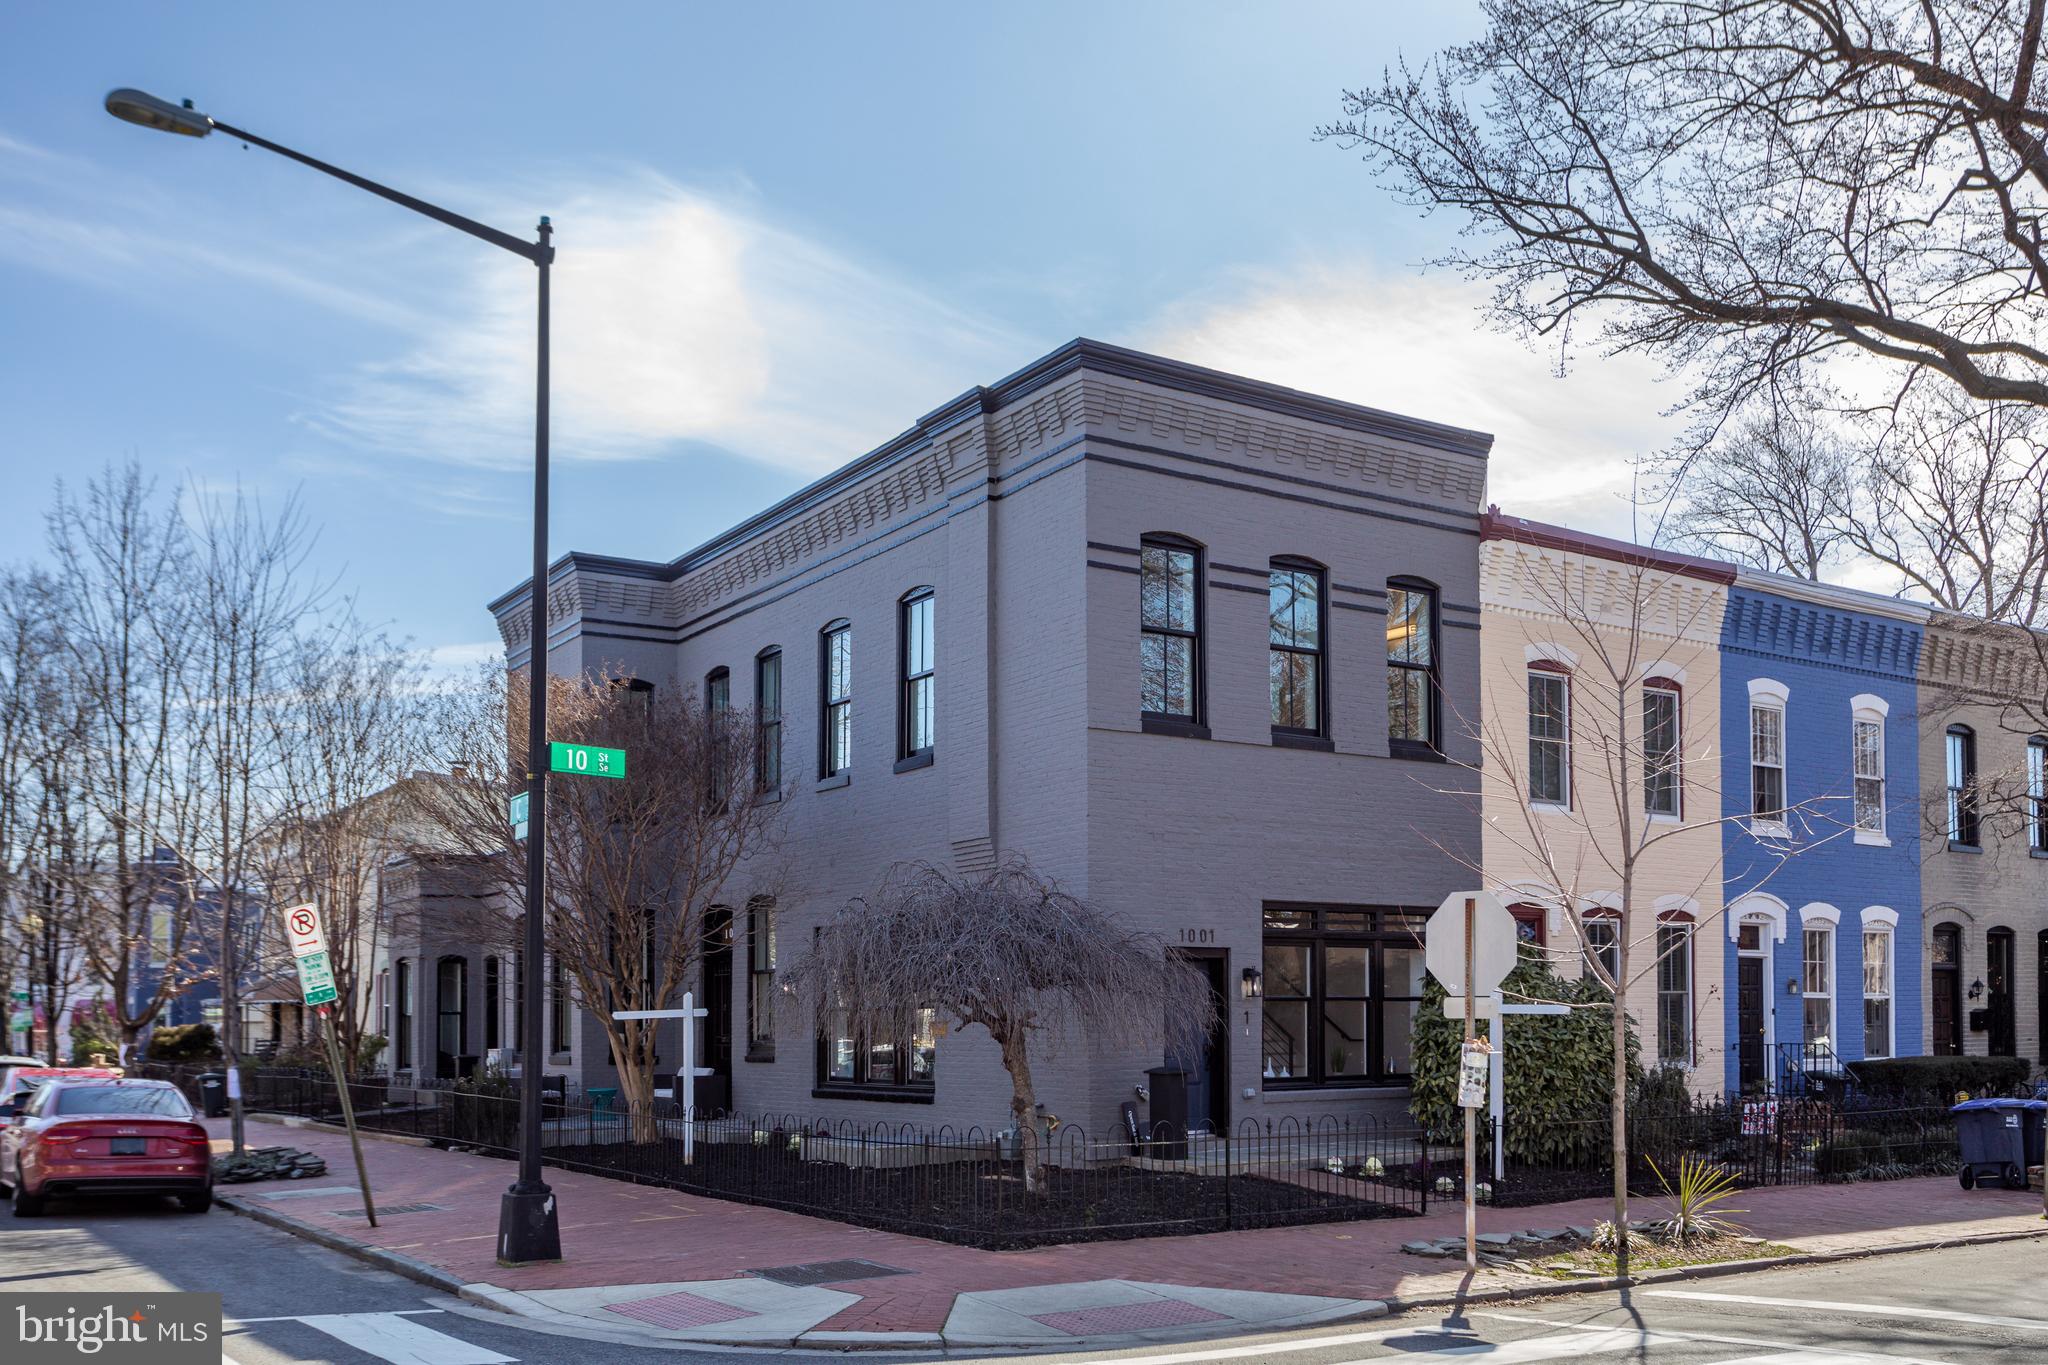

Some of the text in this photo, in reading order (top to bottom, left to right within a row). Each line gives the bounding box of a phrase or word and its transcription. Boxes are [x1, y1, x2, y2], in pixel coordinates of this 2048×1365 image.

[566, 748, 588, 771] 10
[598, 752, 609, 763] St
[598, 762, 609, 773] Se
[1179, 928, 1215, 943] 1001
